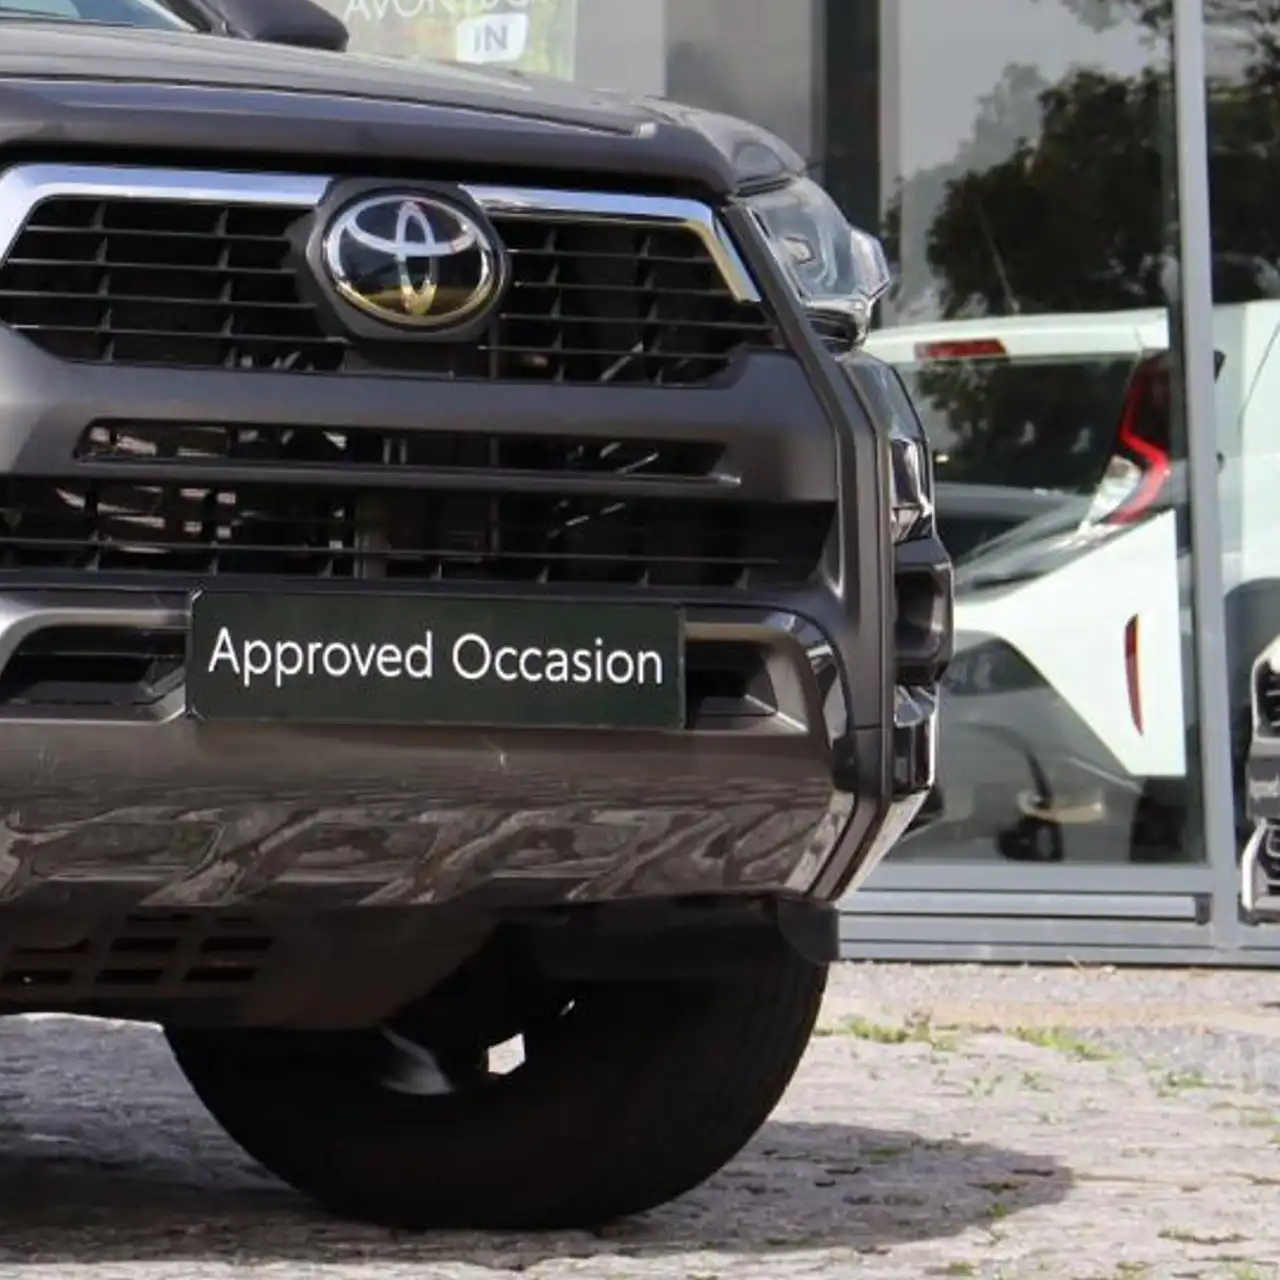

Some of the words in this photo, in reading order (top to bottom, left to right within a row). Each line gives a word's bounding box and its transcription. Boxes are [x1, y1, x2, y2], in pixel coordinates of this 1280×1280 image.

[474, 24, 508, 53] IN
[209, 627, 433, 686] Approved
[452, 634, 663, 684] Occasion
